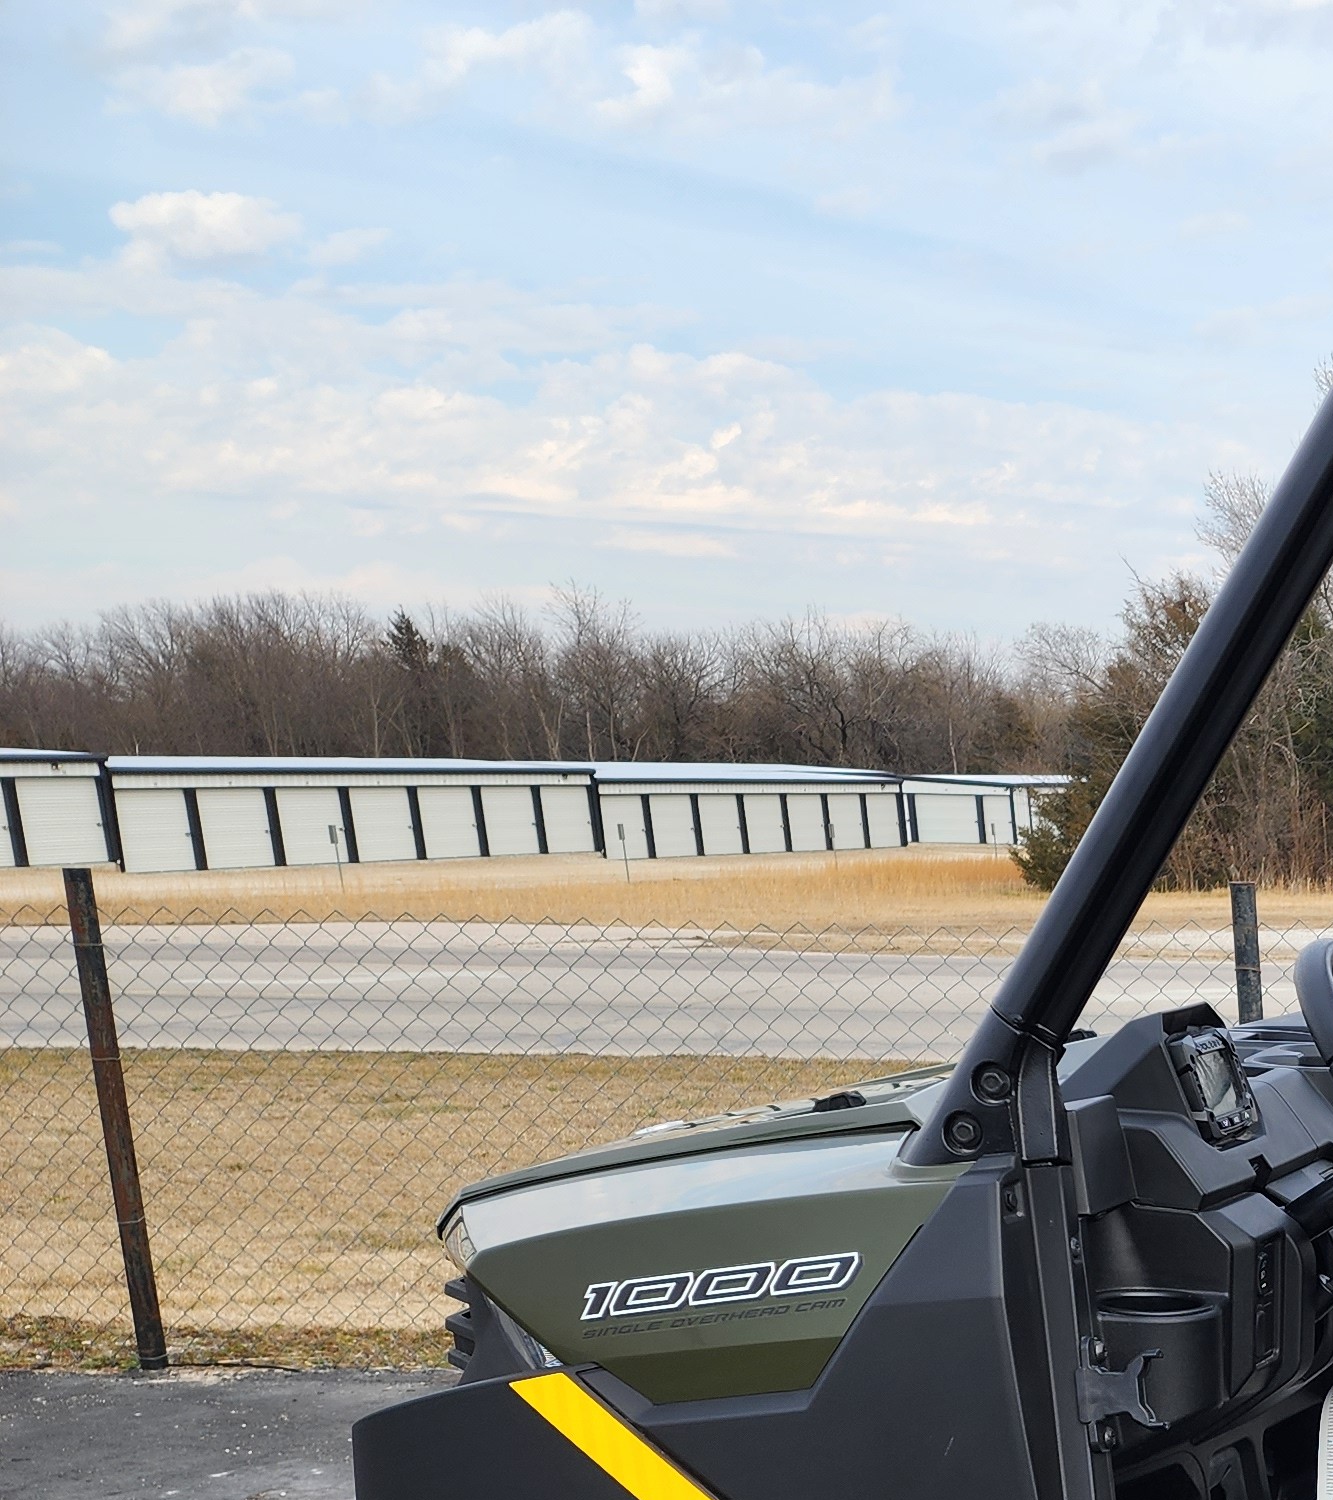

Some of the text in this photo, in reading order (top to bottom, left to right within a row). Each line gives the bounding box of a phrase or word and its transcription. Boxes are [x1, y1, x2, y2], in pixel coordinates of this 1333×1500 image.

[580, 1251, 863, 1321] 1000
[582, 1297, 848, 1340] SINGLE OVERHEAD CAM
